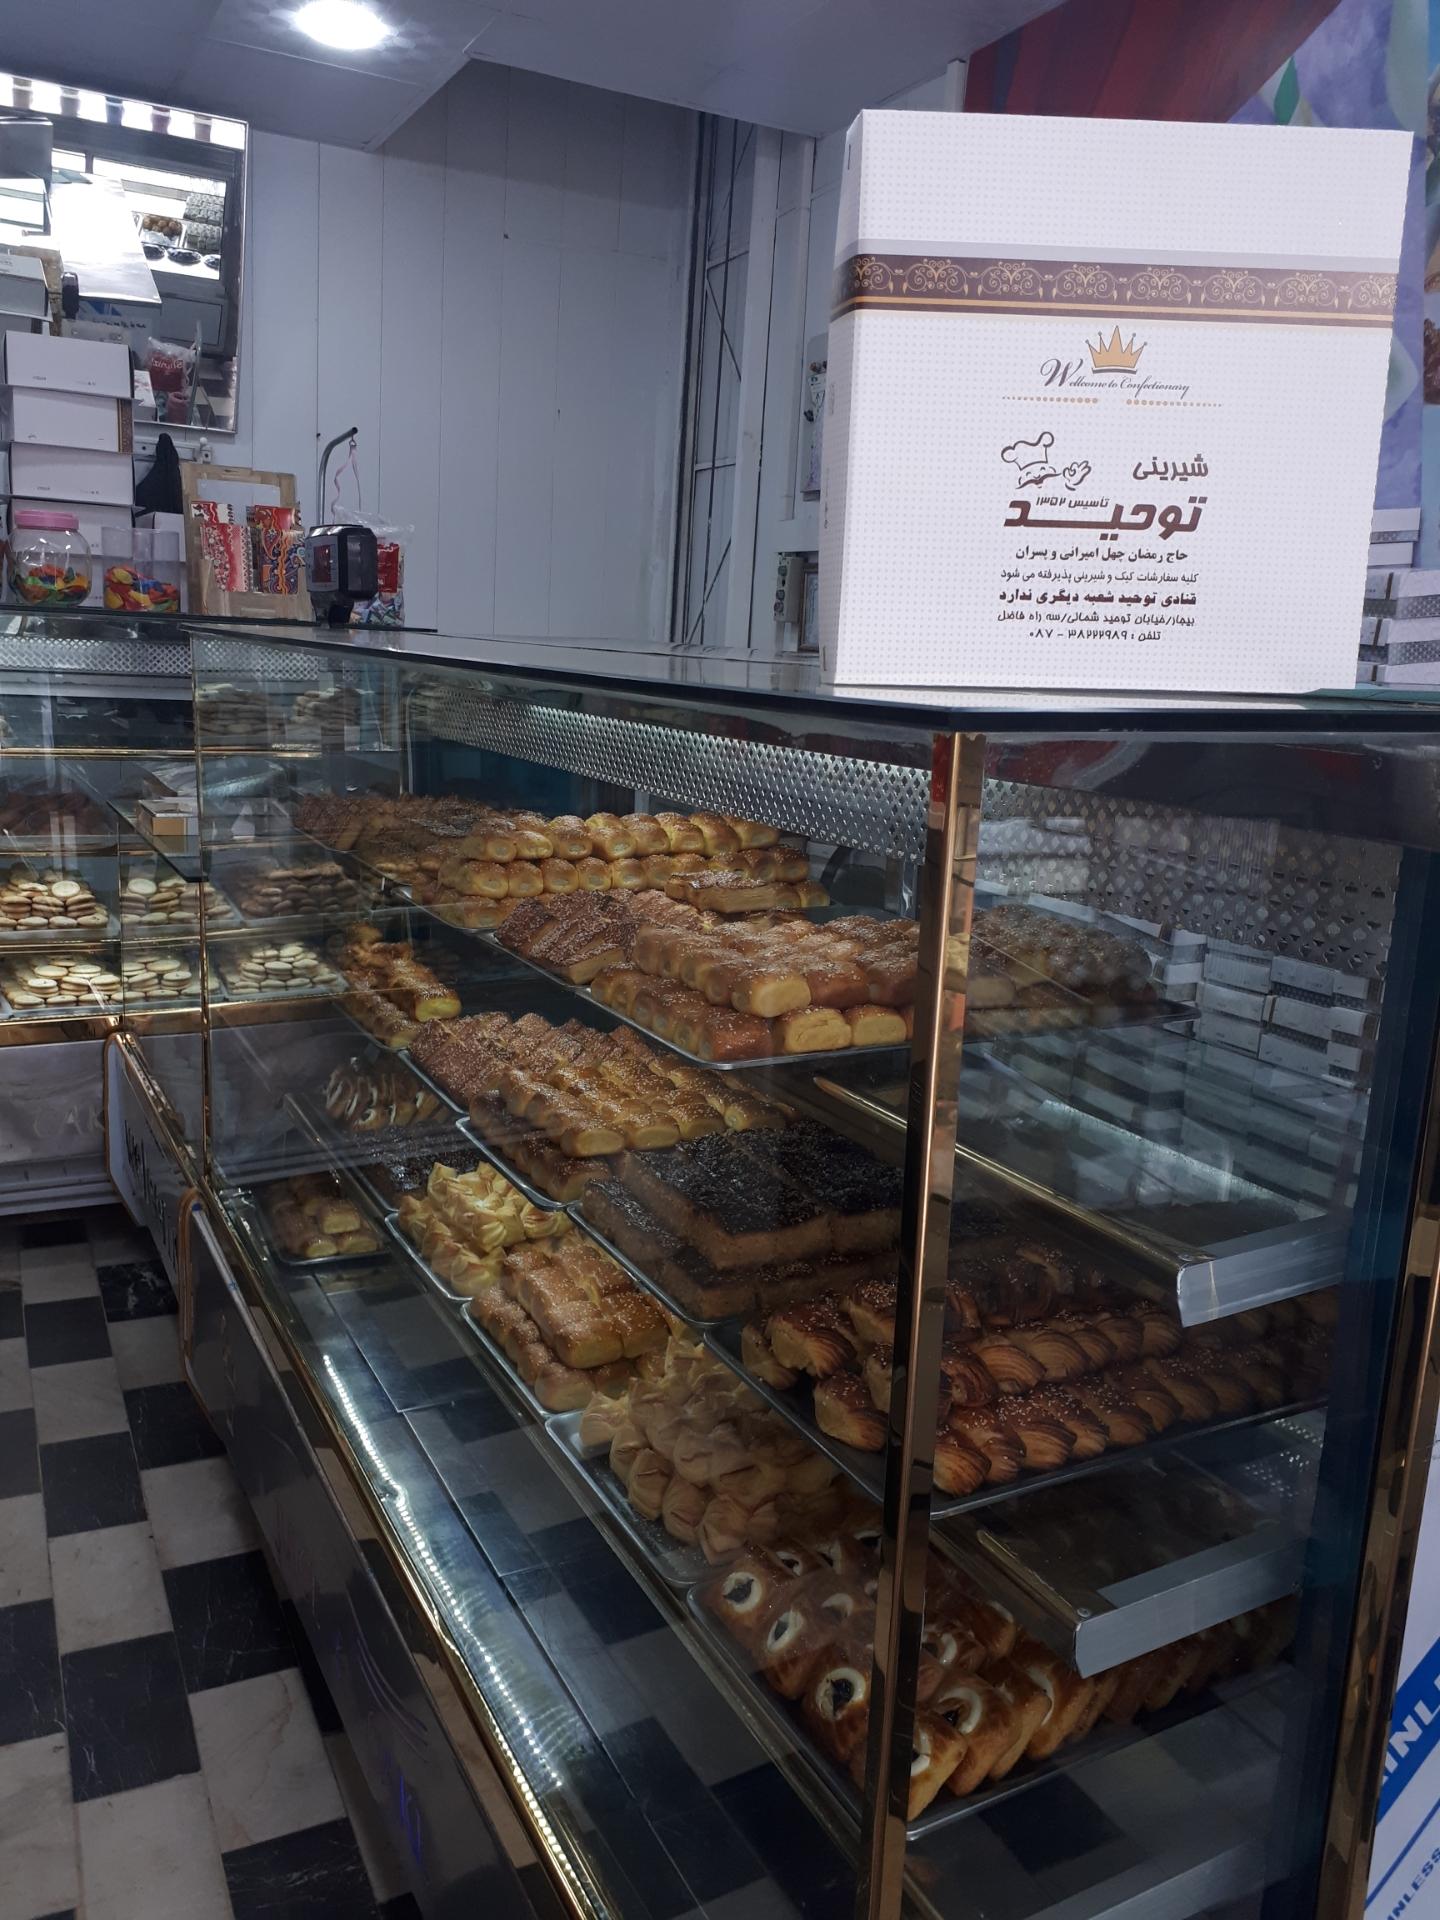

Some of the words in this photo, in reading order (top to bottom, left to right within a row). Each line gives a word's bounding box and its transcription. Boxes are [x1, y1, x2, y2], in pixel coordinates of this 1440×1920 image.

[1040, 358, 1107, 388] Wellcome
[1108, 380, 1118, 388] to
[1120, 375, 1191, 399] Confectionary
[1133, 453, 1209, 481] شیرینی
[1036, 496, 1066, 507] ۱۳۵۲
[1004, 496, 1208, 541] توحید
[1015, 545, 1048, 560] پسران
[1050, 551, 1057, 560] و
[1059, 546, 1099, 561] امیرانی
[1101, 547, 1125, 562] چهل
[1128, 549, 1163, 563] رمضان
[1166, 549, 1188, 563] حاج
[1000, 568, 1020, 582] شود
[1022, 573, 1035, 582] می
[1038, 569, 1072, 584] پذیرفته
[1073, 570, 1106, 584] شیرینی
[1107, 575, 1113, 584] و
[1115, 571, 1135, 582] کیک
[1137, 571, 1178, 584] سفارشات
[1180, 573, 1199, 585] کلیه
[999, 588, 1032, 604] ندارد
[1036, 588, 1079, 605] دیگری
[1083, 590, 1114, 605] شعبه
[1118, 592, 1158, 606] توحید
[1160, 592, 1197, 607] قنادی
[997, 609, 1025, 622] فاضل
[1029, 612, 1042, 622] راه
[1381, 1672, 1440, 1786] INL
